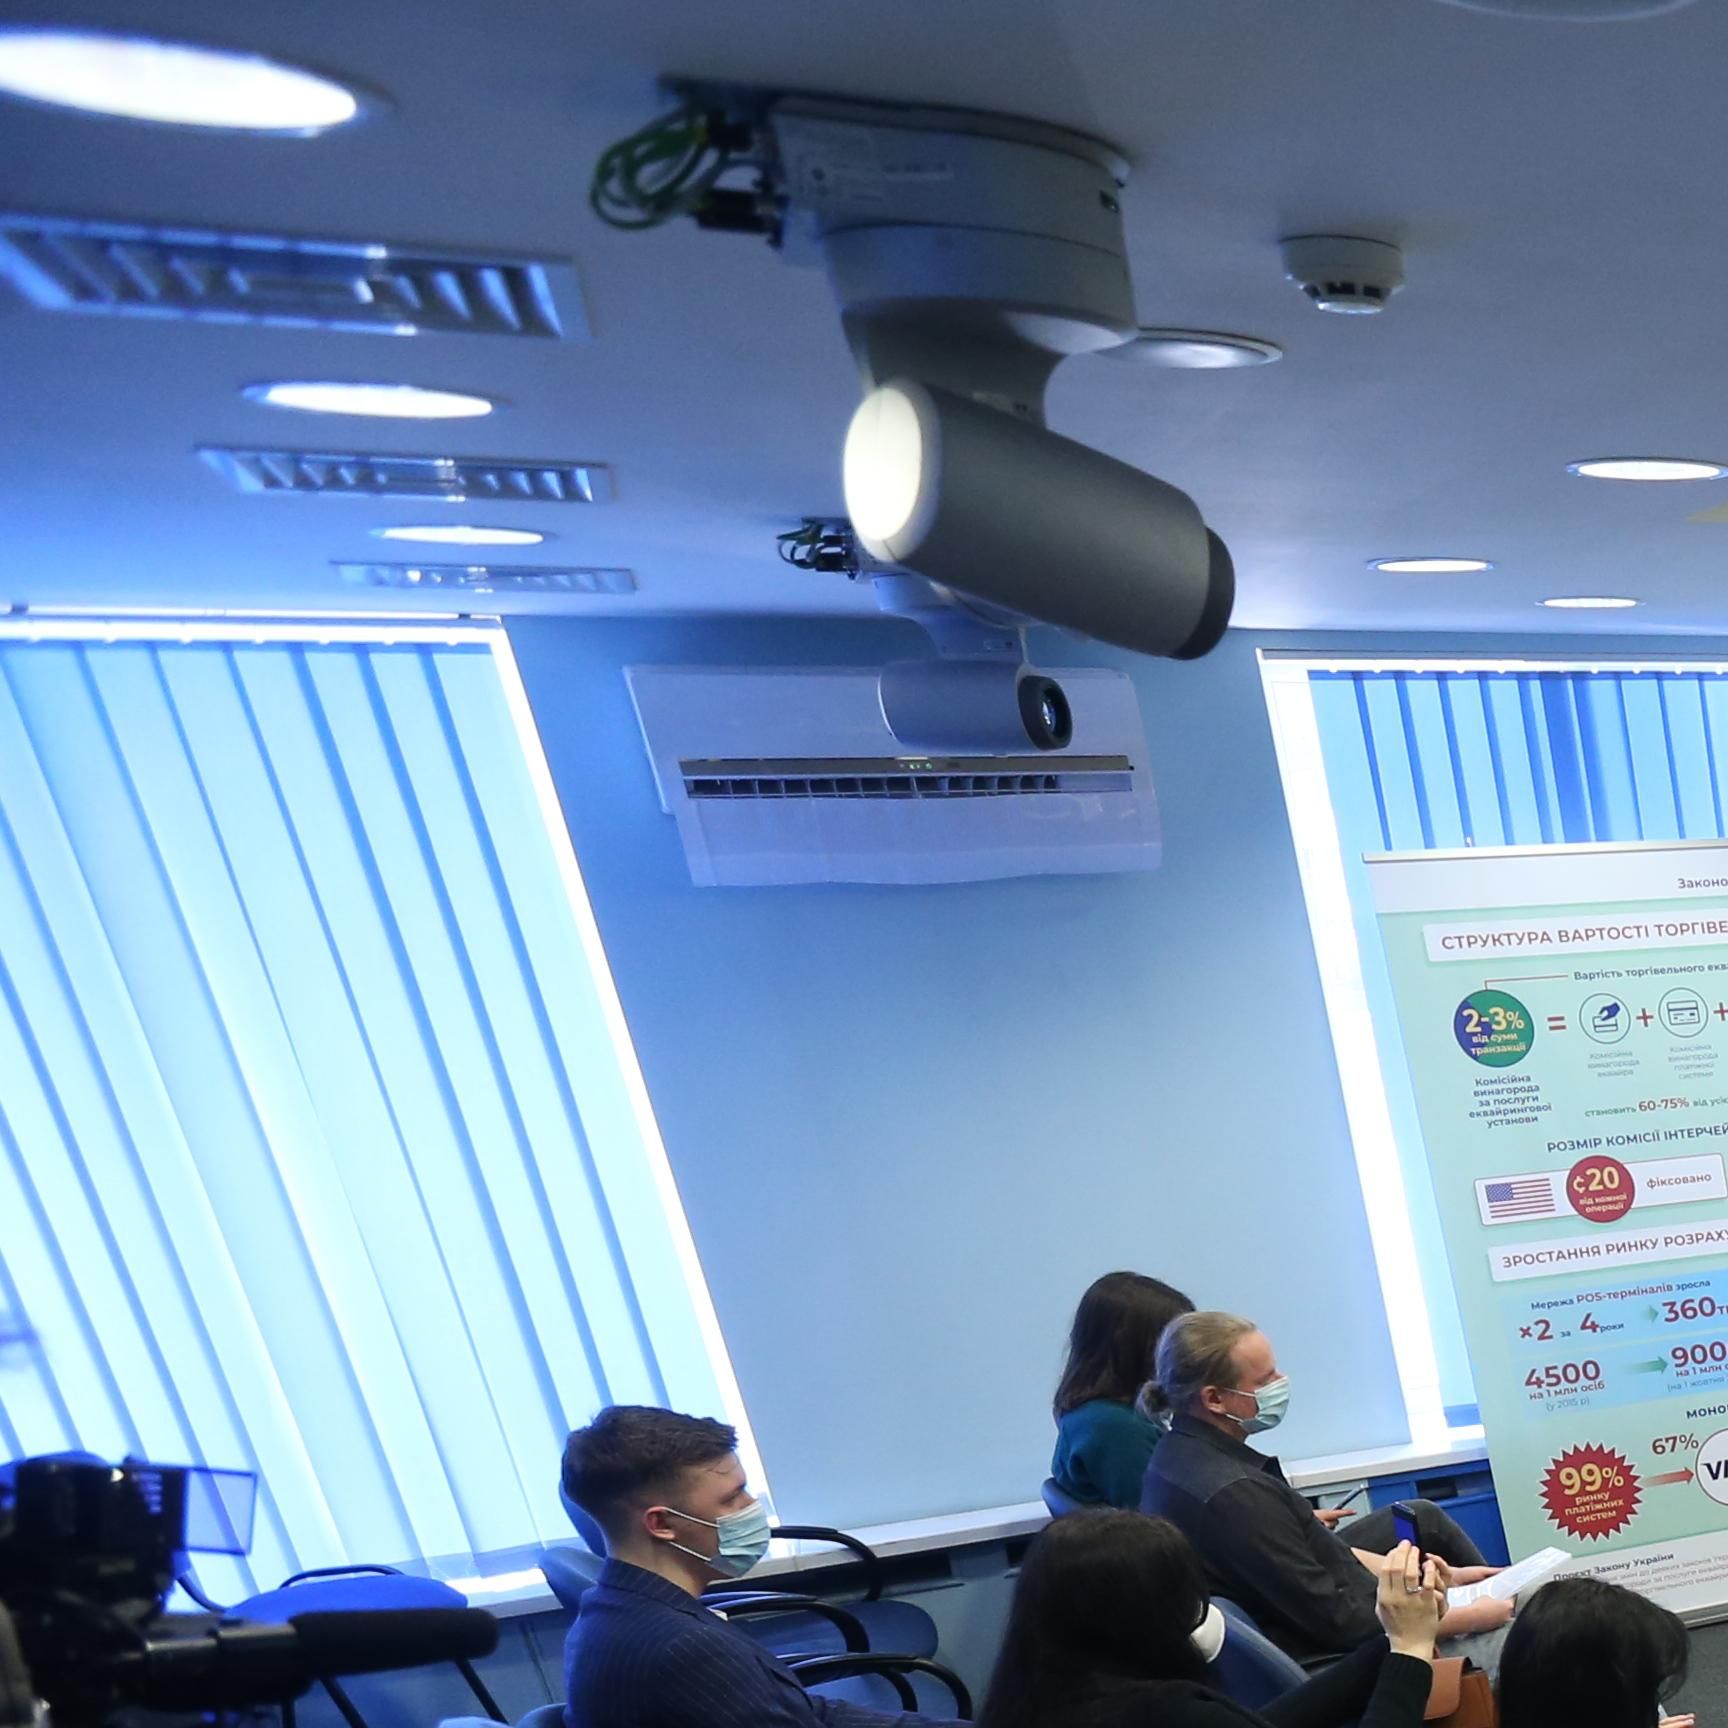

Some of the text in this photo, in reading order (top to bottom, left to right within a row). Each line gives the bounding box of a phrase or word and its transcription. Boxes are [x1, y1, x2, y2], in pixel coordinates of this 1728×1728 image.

[1441, 931, 1553, 951] СТРУКТУРА
[1557, 925, 1649, 943] ВАРТОСТІ
[1574, 970, 1623, 981] Вартість
[1625, 963, 1705, 979] торгівельного
[1462, 1006, 1525, 1033] 2-3%
[1473, 1084, 1540, 1098] винагорода
[1475, 1075, 1532, 1087] Комісійна
[1469, 1102, 1552, 1119] еквайрингової
[1478, 1094, 1539, 1108] за послуги
[1585, 1106, 1636, 1117] становить
[1638, 1097, 1690, 1112] 60-75%
[1487, 1115, 1538, 1129] установи
[1547, 1137, 1601, 1152] РОЗМІР
[1606, 1131, 1660, 1147] КОМІСІЇ
[1646, 1172, 1712, 1190] фіксовано
[1503, 1245, 1601, 1269] ЗРОСТАННЯ
[1606, 1237, 1659, 1255] РИНКУ
[1531, 1297, 1574, 1311] Мережа
[1676, 1279, 1711, 1291] зросла
[1560, 1329, 1571, 1338] за
[1580, 1312, 1600, 1333] 4
[1524, 1359, 1601, 1389] 4500
[1676, 1370, 1689, 1378] на
[1692, 1367, 1697, 1376] 1
[1699, 1364, 1722, 1374] млн
[1529, 1379, 1605, 1401] на 1 млн осіб
[1652, 1433, 1699, 1456] 67%
[1559, 1462, 1624, 1495] 99%
[1564, 1499, 1625, 1516] платіжних
[1575, 1490, 1610, 1506] ринку
[1576, 1509, 1617, 1524] систем
[1594, 1562, 1631, 1575] Закону
[1633, 1552, 1674, 1567] України
